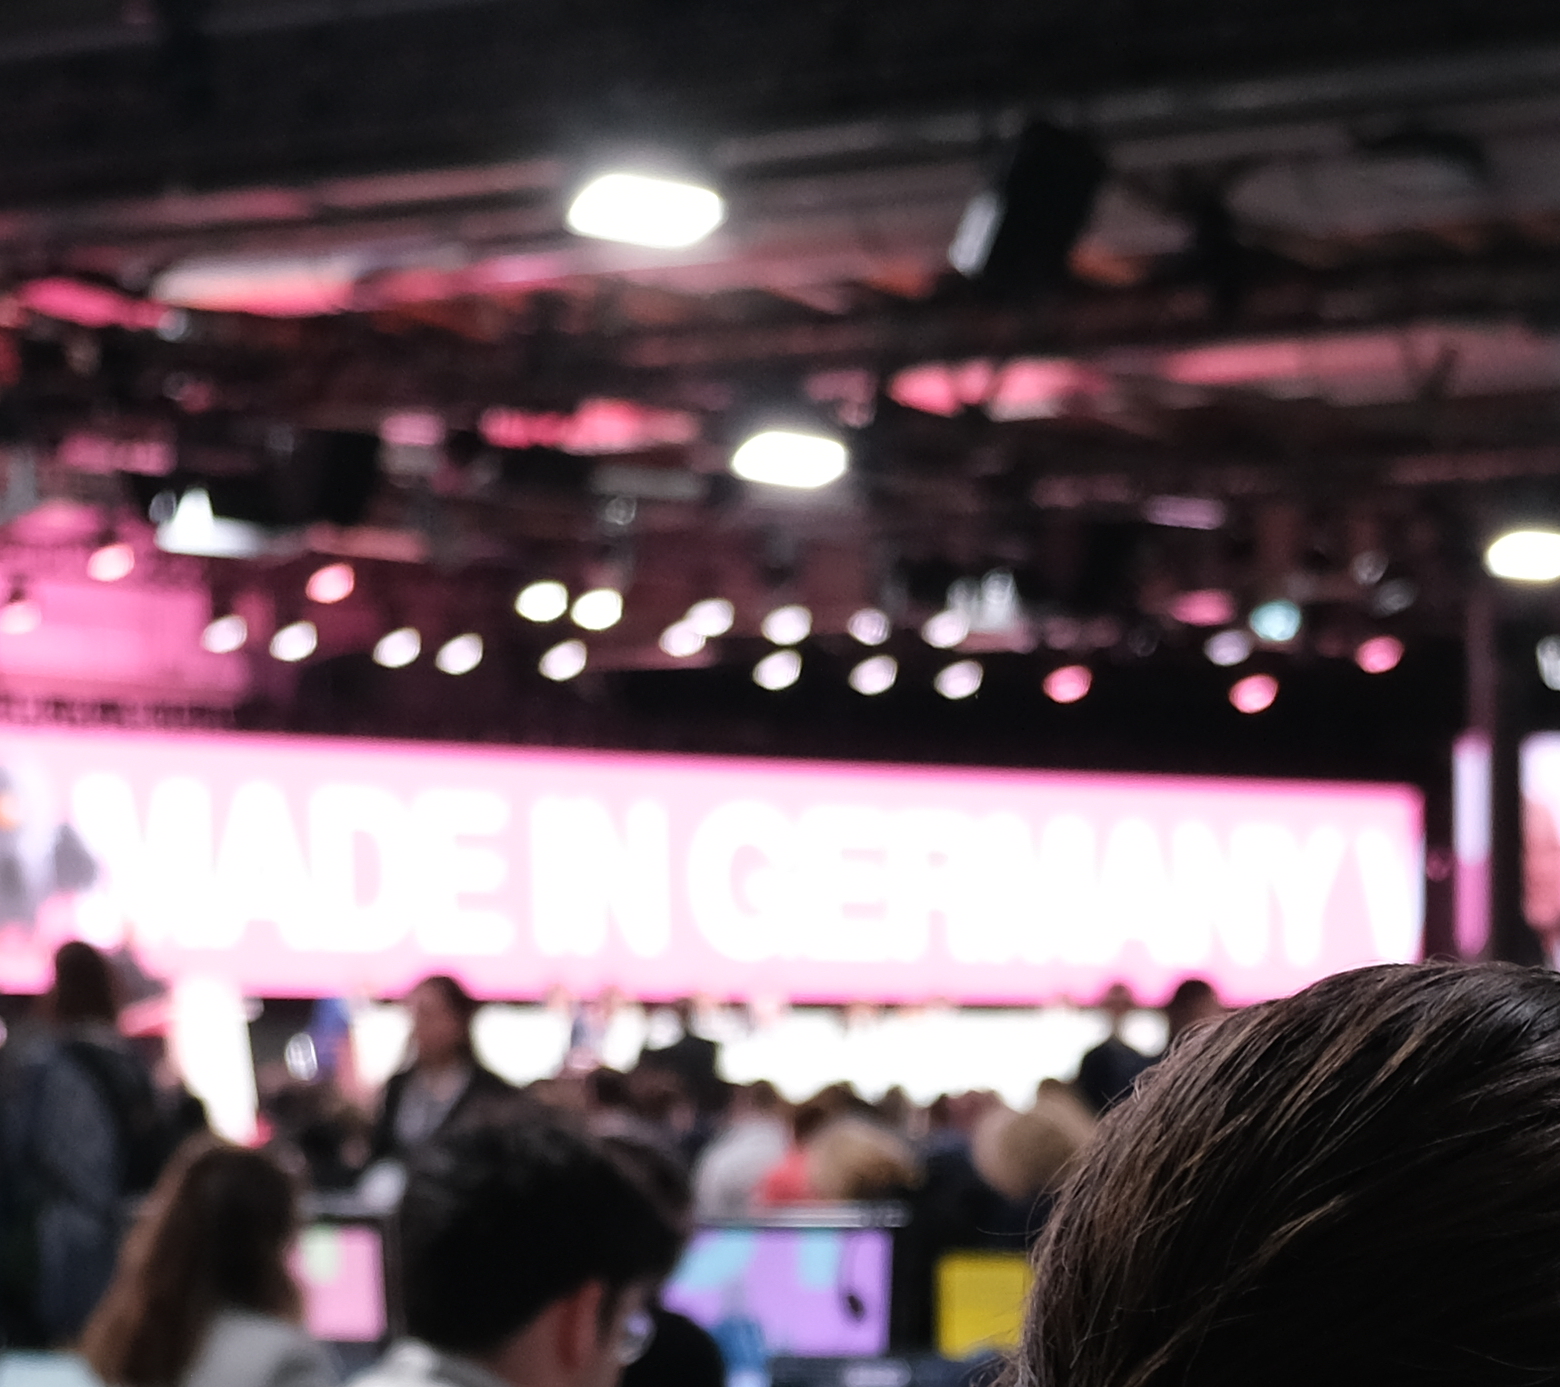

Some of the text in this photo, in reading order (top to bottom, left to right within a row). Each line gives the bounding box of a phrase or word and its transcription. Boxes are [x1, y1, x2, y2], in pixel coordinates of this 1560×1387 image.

[70, 770, 512, 957] MADE
[527, 792, 671, 957] IN
[683, 797, 1345, 969] GERMANY
